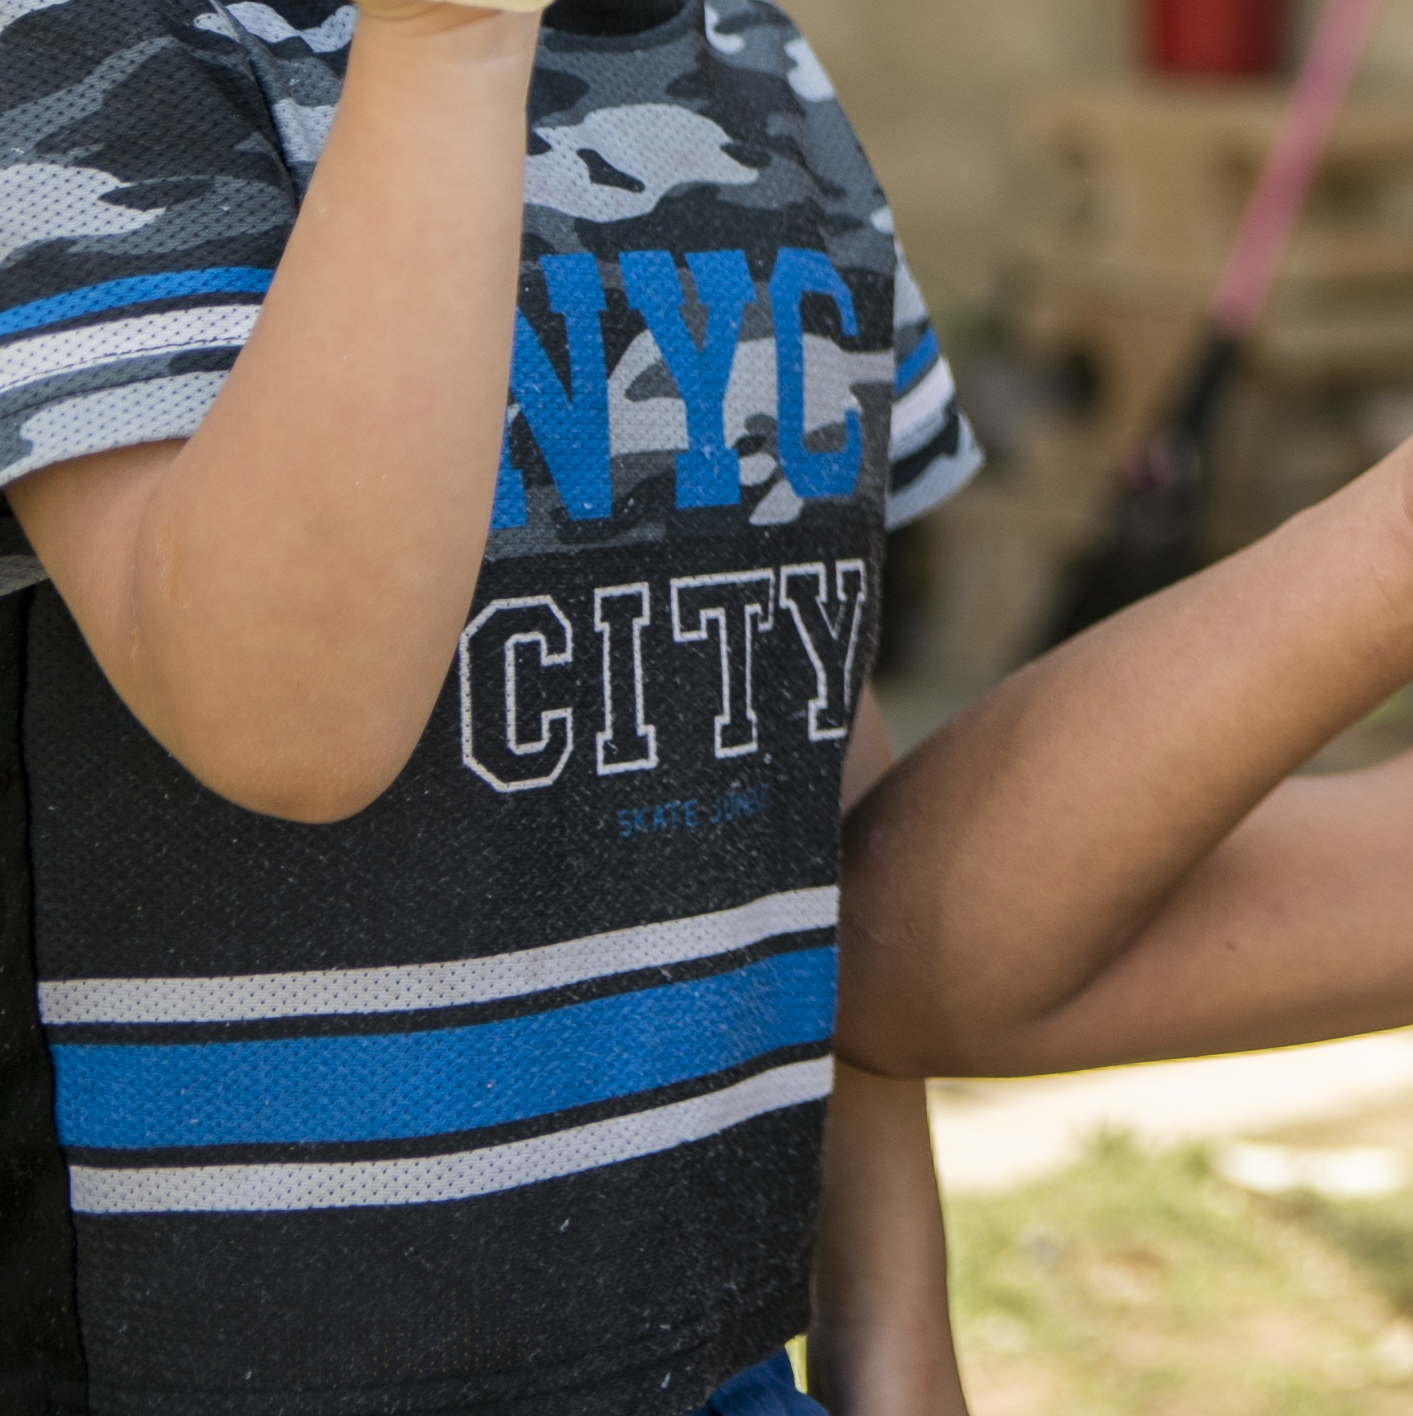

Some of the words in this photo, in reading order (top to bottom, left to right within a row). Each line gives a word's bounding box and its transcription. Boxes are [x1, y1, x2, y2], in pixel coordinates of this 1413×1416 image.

[489, 246, 863, 529] NYC
[459, 559, 867, 792] CITY
[616, 797, 700, 838] SKATE
